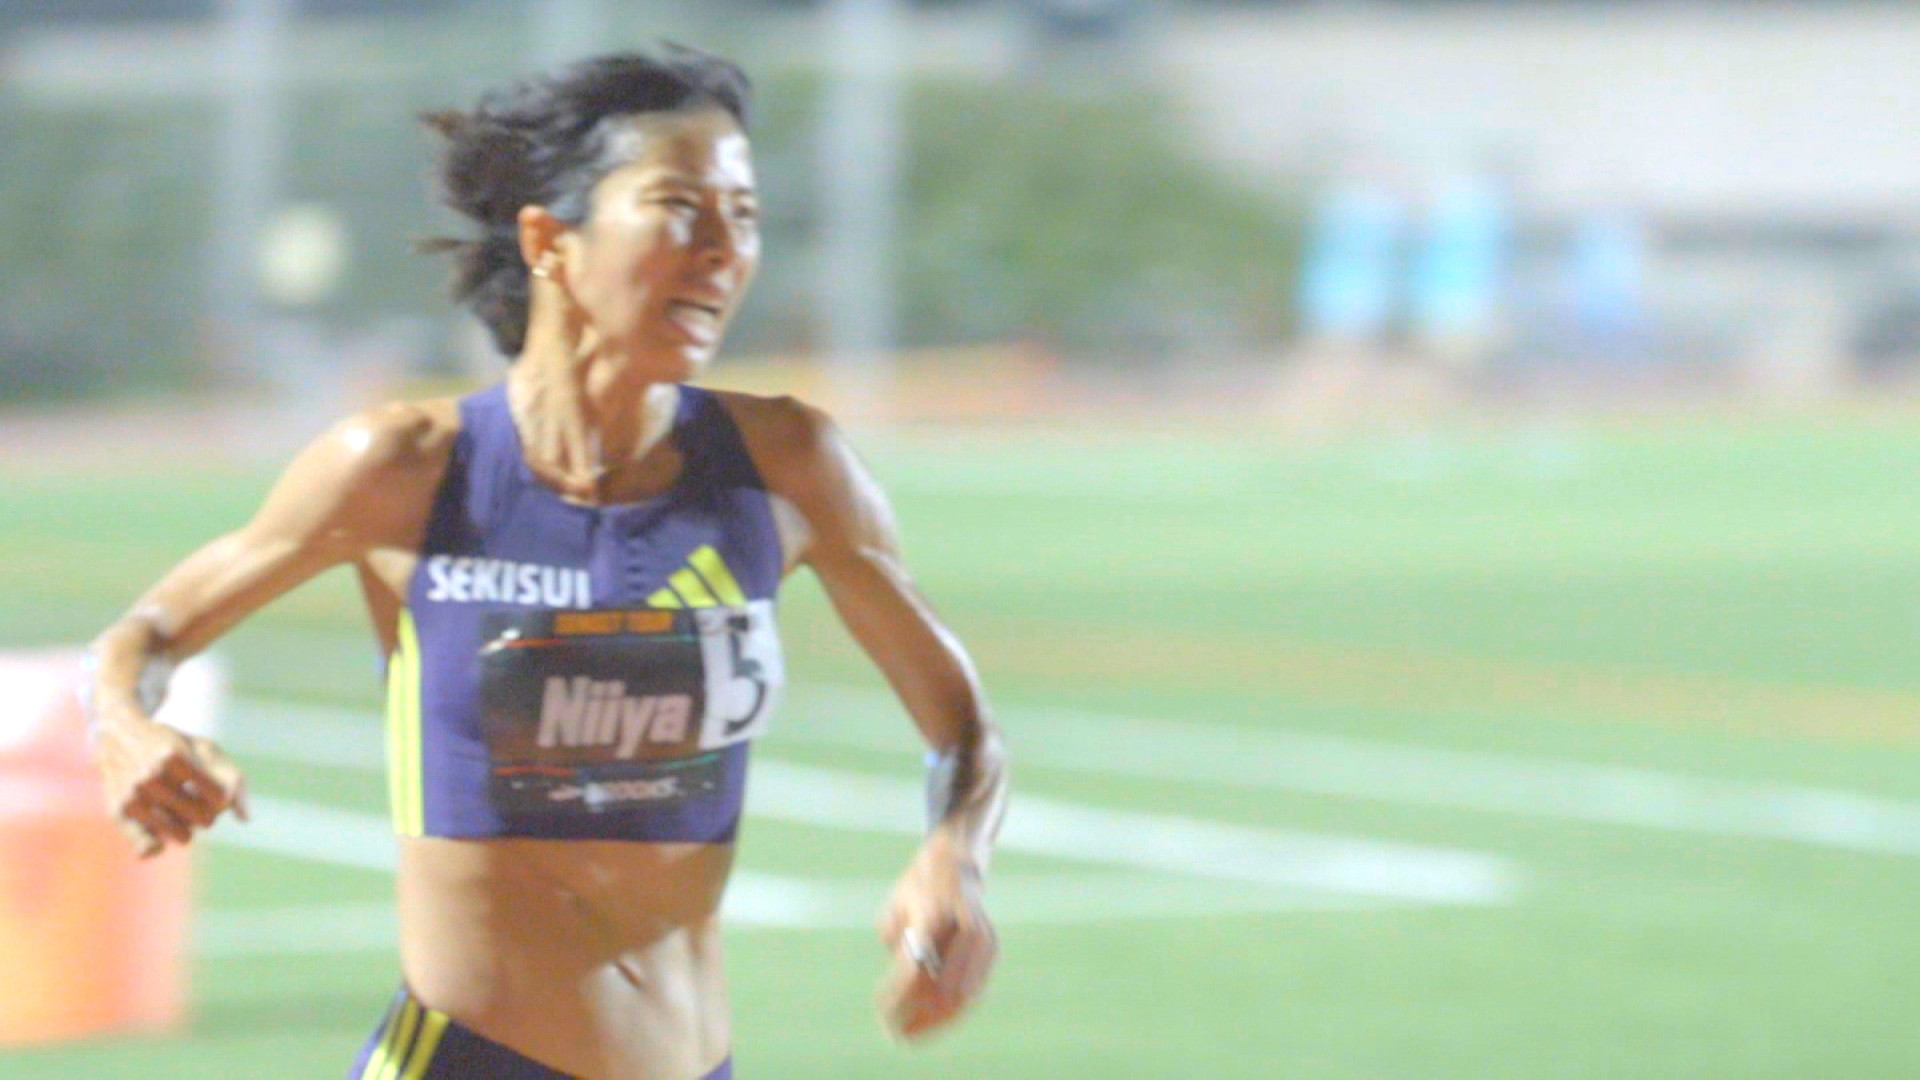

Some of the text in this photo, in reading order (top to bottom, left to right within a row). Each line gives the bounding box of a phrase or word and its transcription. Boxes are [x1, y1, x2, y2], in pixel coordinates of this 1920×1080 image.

[427, 556, 591, 608] SEKISUI
[722, 614, 766, 736] 5
[538, 677, 693, 760] Niiya
